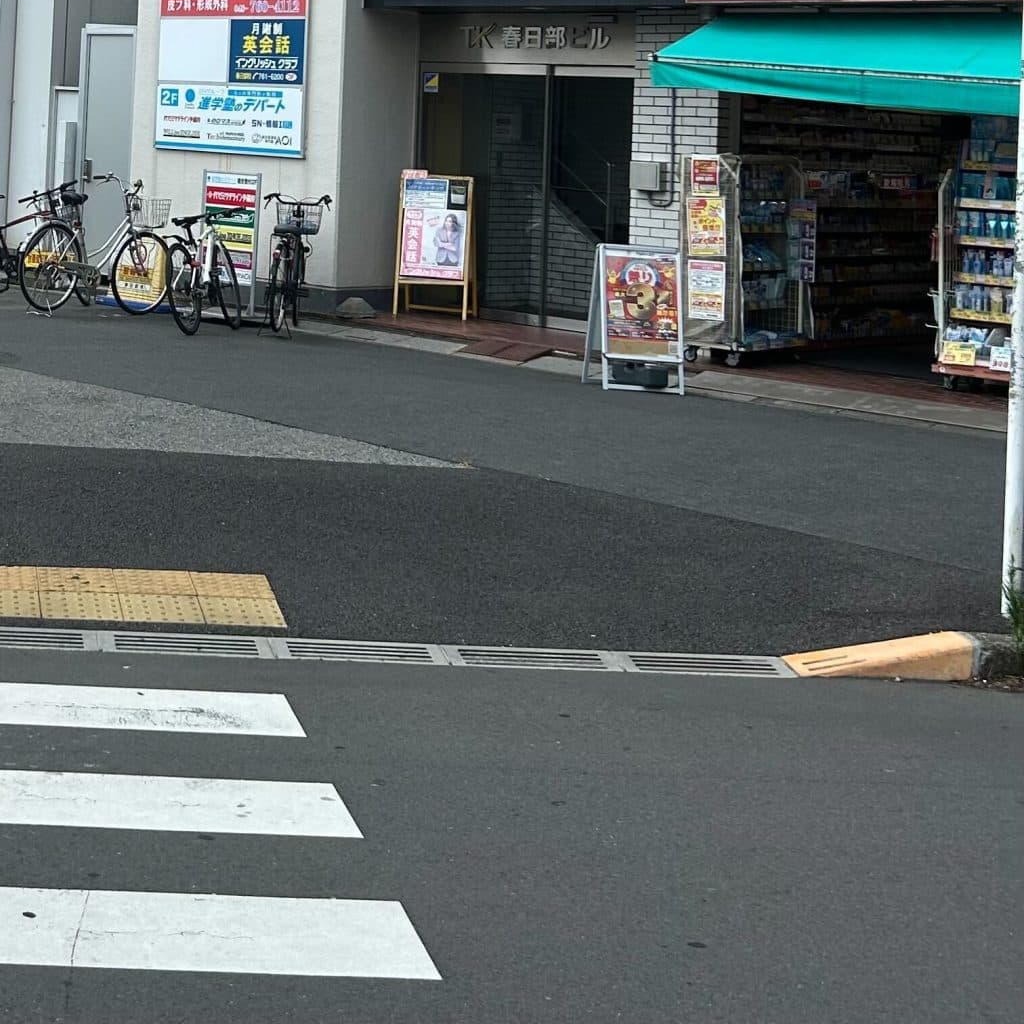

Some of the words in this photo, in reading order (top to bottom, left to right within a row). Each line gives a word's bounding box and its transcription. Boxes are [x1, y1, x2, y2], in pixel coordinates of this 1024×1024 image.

[241, 34, 291, 55] 英会話
[460, 22, 612, 50] TK春日部ビル
[161, 90, 178, 106] 2F
[197, 96, 286, 114] 進学塾のデパート
